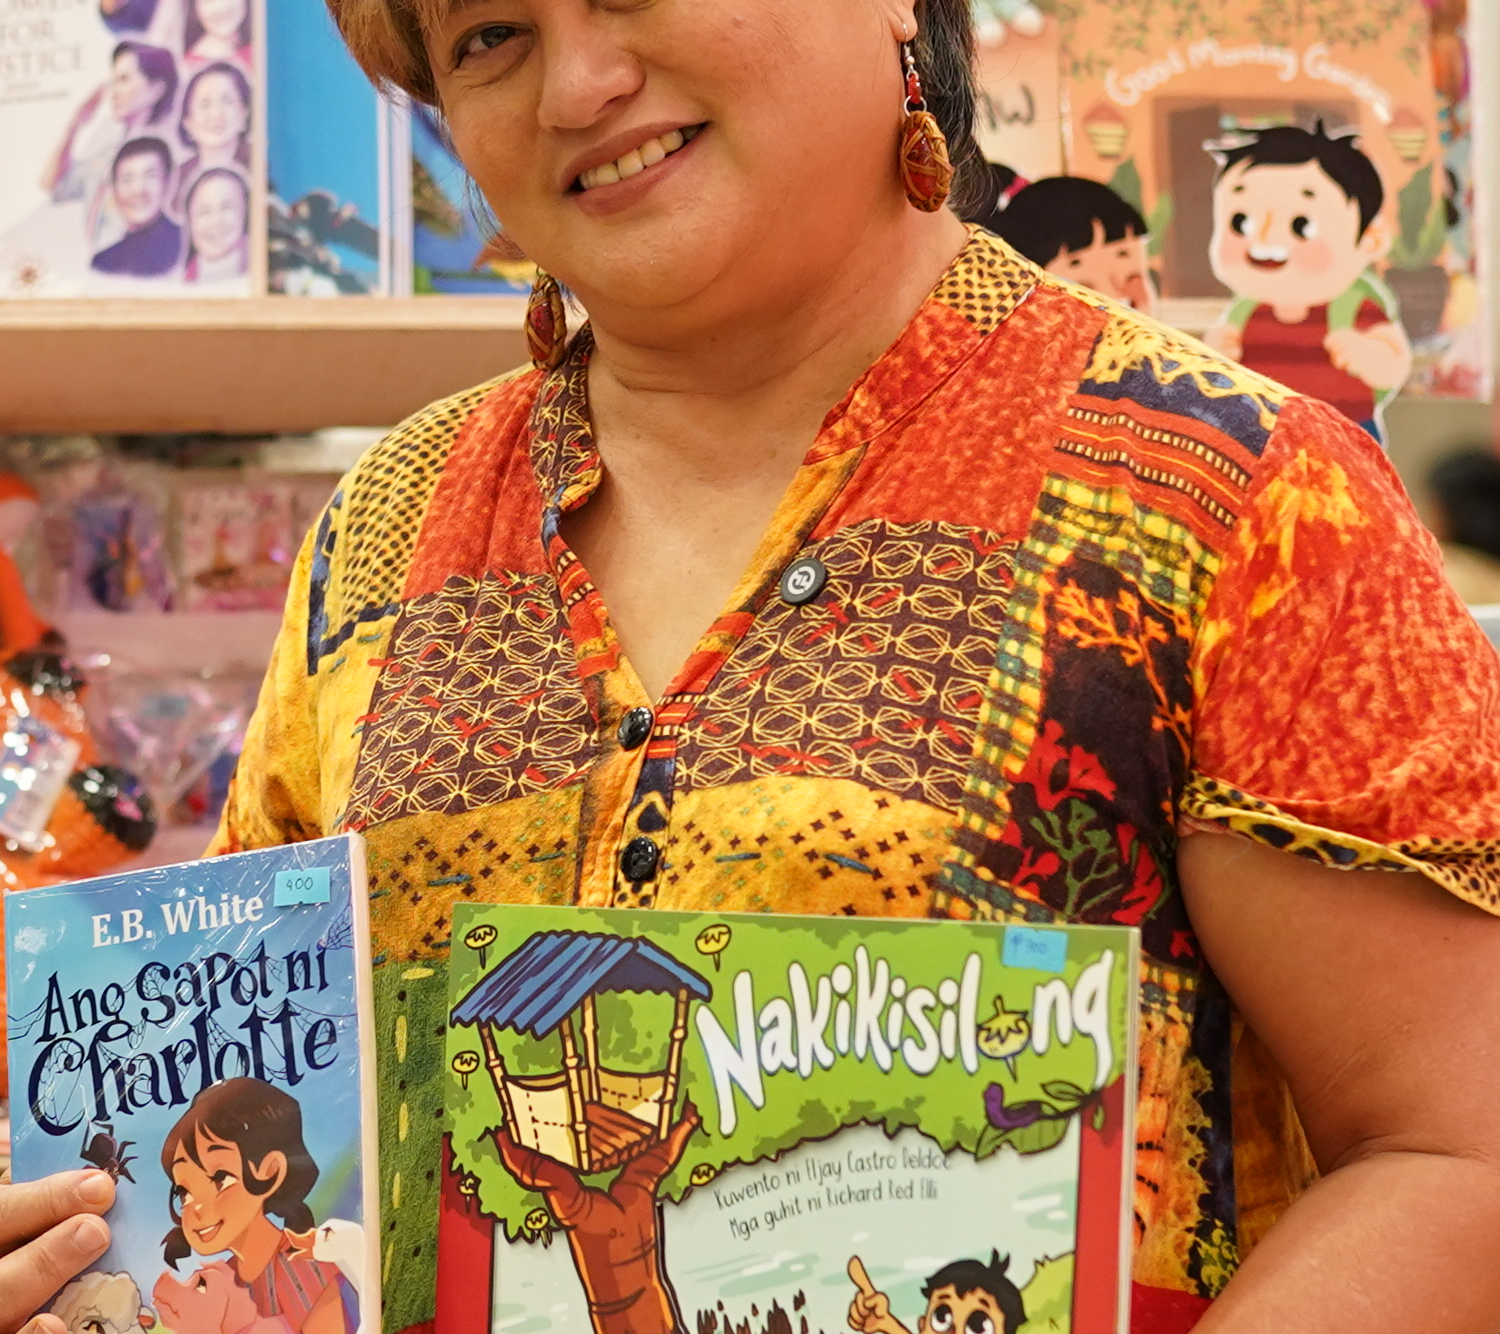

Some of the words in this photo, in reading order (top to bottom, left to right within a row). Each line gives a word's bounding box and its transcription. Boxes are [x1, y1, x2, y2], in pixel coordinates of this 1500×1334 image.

[1104, 48, 1187, 107] Good
[1187, 37, 1299, 83] Morning
[285, 877, 314, 891] 400
[91, 908, 154, 949] E.B.
[160, 894, 265, 936] White
[33, 970, 134, 1044] Ang
[282, 944, 330, 994] ni
[27, 998, 340, 1137] Charlotte
[713, 1172, 781, 1211] Kuwento
[785, 1164, 801, 1185] ni
[846, 1149, 898, 1174] Castro
[729, 1217, 760, 1242] Mga
[763, 1197, 803, 1232] guhit
[807, 1198, 822, 1214] ni
[825, 1181, 883, 1208] Richard
